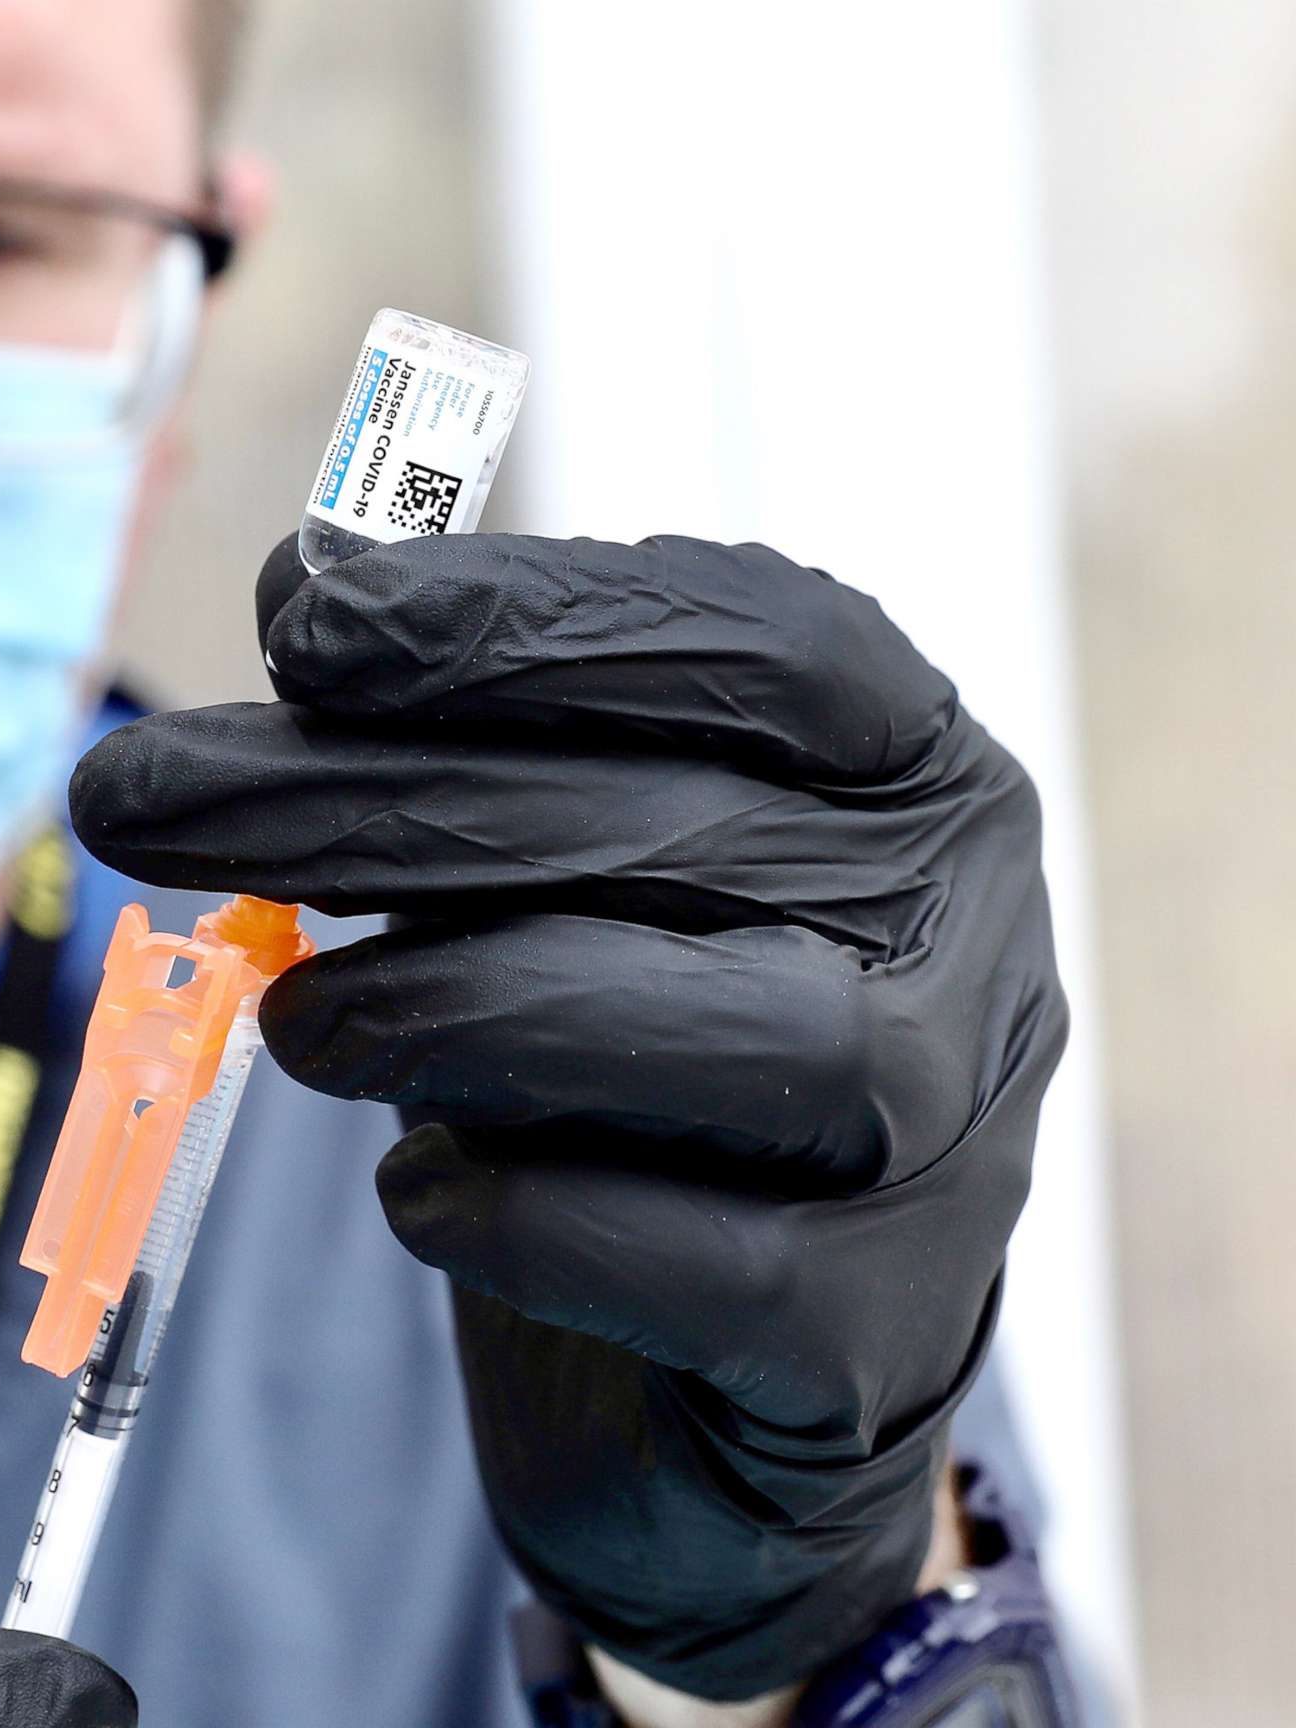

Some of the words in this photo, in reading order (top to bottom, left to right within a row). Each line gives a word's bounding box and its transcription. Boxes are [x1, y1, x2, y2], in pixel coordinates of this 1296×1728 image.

[372, 355, 383, 368] 5
[368, 358, 402, 424] Vaccine
[431, 371, 445, 390] Use
[463, 382, 475, 399] For
[352, 368, 378, 420] doses
[382, 361, 416, 431] Janssen
[403, 367, 433, 437] Authorization
[427, 375, 455, 431] Emergency
[449, 379, 464, 409] under
[456, 400, 468, 418] use
[472, 390, 495, 436] 10556700
[345, 424, 357, 445] of
[335, 445, 351, 472] 0.5
[324, 473, 339, 500] mL
[353, 435, 391, 518] COVID-19
[100, 1309, 115, 1334] 5
[83, 1363, 96, 1387] 6
[66, 1414, 81, 1437] 7
[48, 1469, 62, 1493] 8
[31, 1522, 45, 1545] 9
